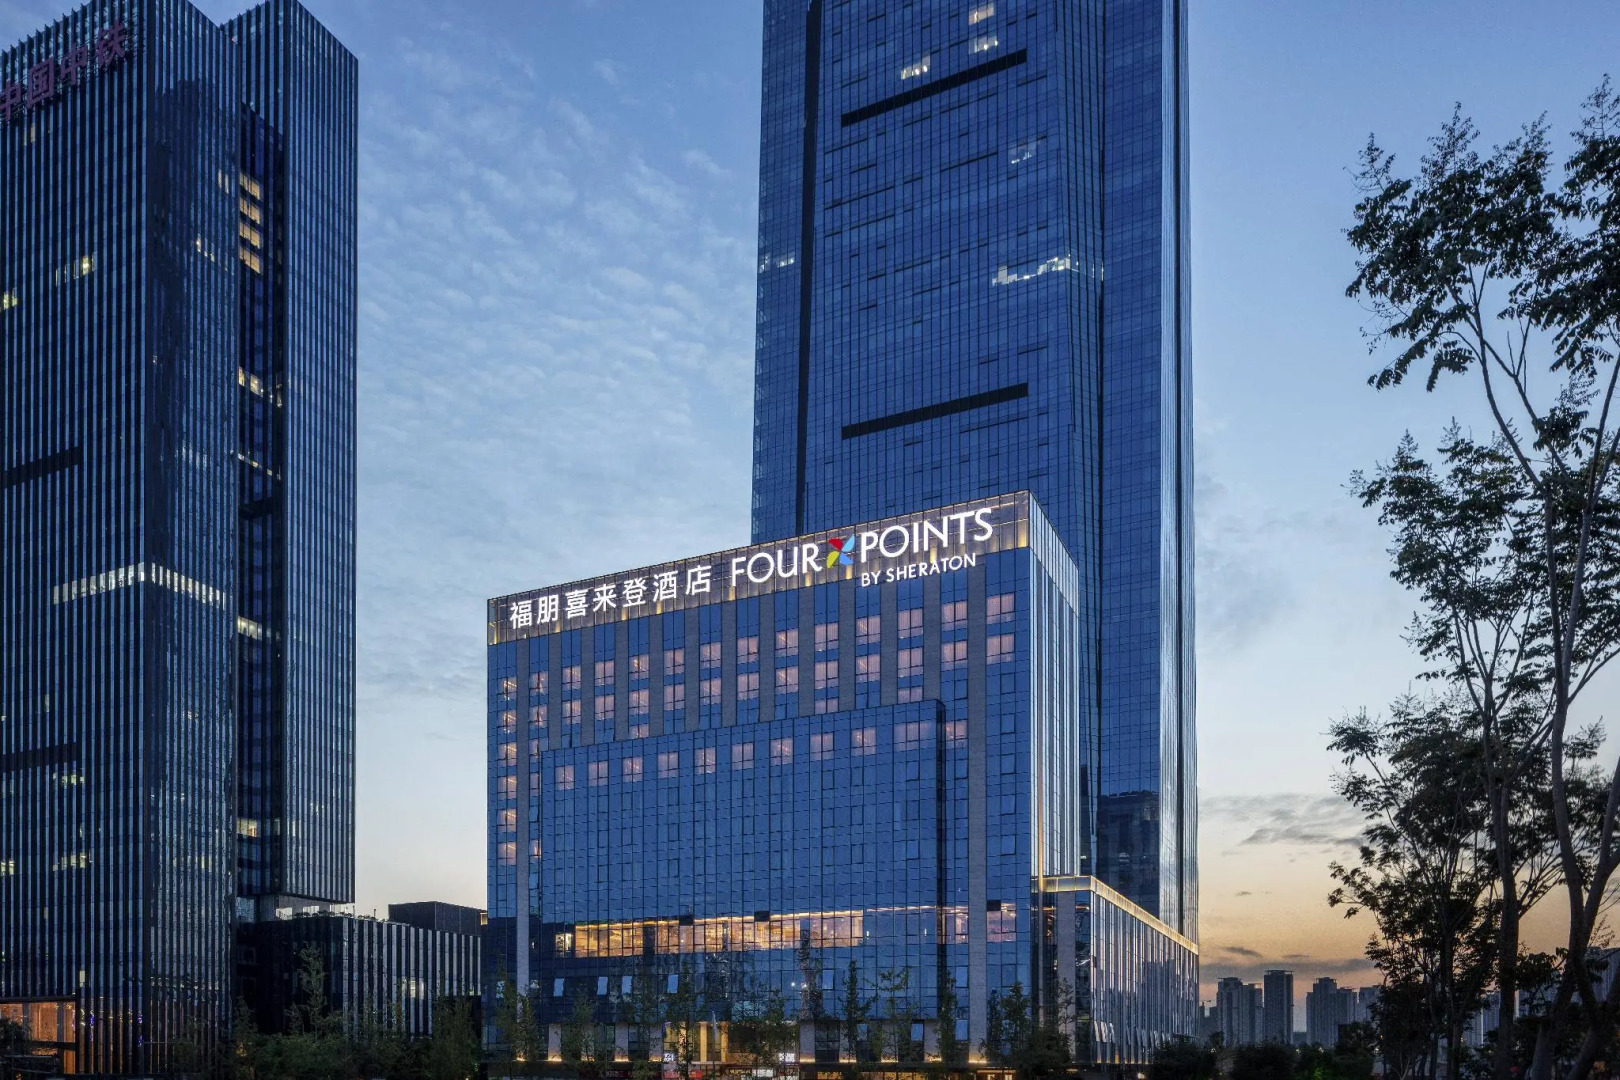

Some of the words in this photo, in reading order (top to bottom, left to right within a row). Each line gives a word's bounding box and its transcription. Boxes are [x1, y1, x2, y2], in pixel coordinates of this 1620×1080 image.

[730, 543, 822, 586] FOUR
[860, 508, 993, 563] POINTS
[861, 571, 881, 587] BY
[886, 553, 976, 581] SHERATON
[509, 565, 712, 629] 福朋喜来登酒店
